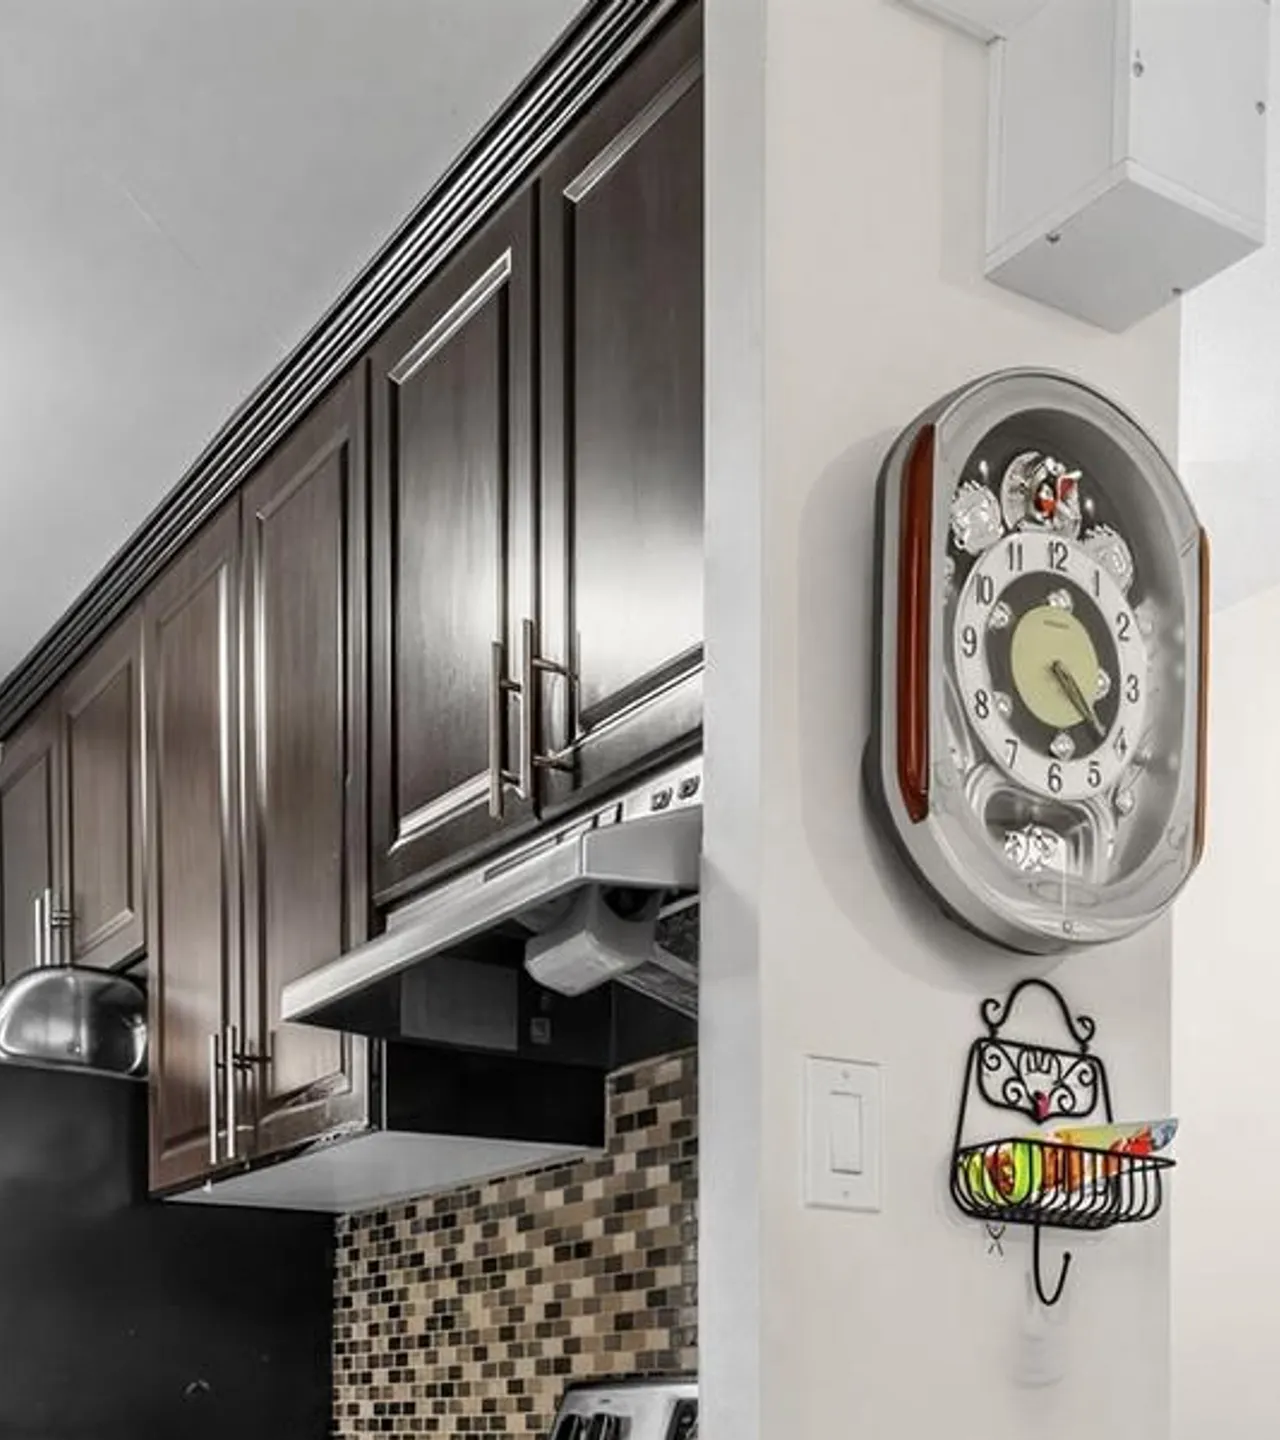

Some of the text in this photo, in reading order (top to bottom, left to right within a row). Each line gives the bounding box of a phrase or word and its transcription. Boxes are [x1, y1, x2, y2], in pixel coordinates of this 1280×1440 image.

[1009, 542, 1023, 571] 11
[1048, 541, 1068, 571] 12
[976, 574, 994, 605] 10
[962, 626, 977, 658] 9
[1116, 612, 1131, 642] 2
[1127, 674, 1140, 703] 3
[974, 689, 990, 719] 8
[1005, 739, 1018, 769] 7
[1113, 727, 1128, 755] 4
[1047, 762, 1063, 793] 6
[1087, 761, 1102, 788] 5
